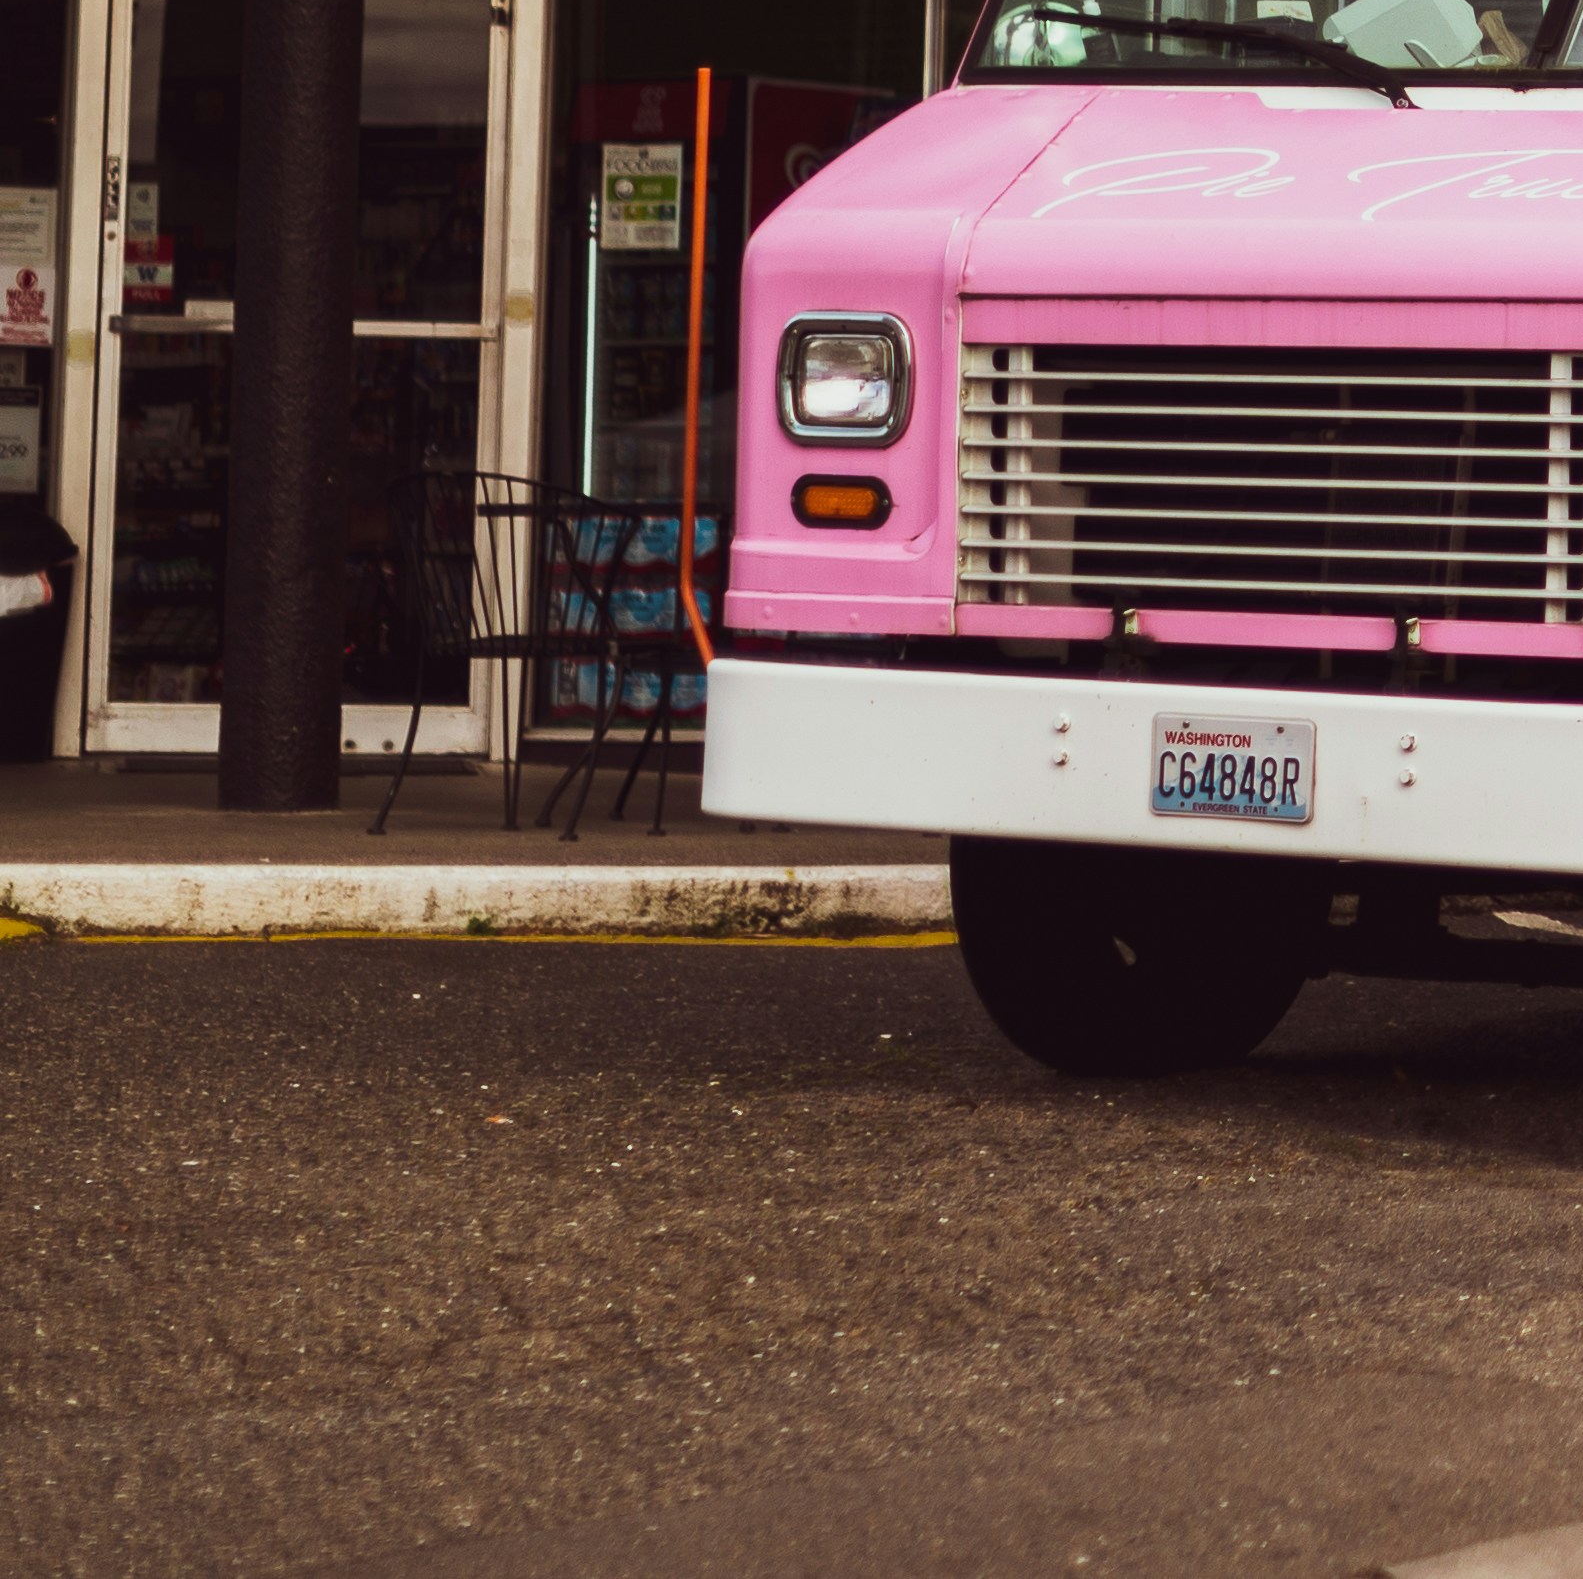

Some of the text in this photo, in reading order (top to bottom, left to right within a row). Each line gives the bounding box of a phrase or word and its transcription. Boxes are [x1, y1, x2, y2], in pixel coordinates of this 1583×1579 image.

[1030, 147, 1296, 219] Pie
[1164, 731, 1252, 748] WASHINGTON
[1159, 751, 1300, 805] C64848R
[1191, 802, 1268, 815] EVERGREEN STATE
